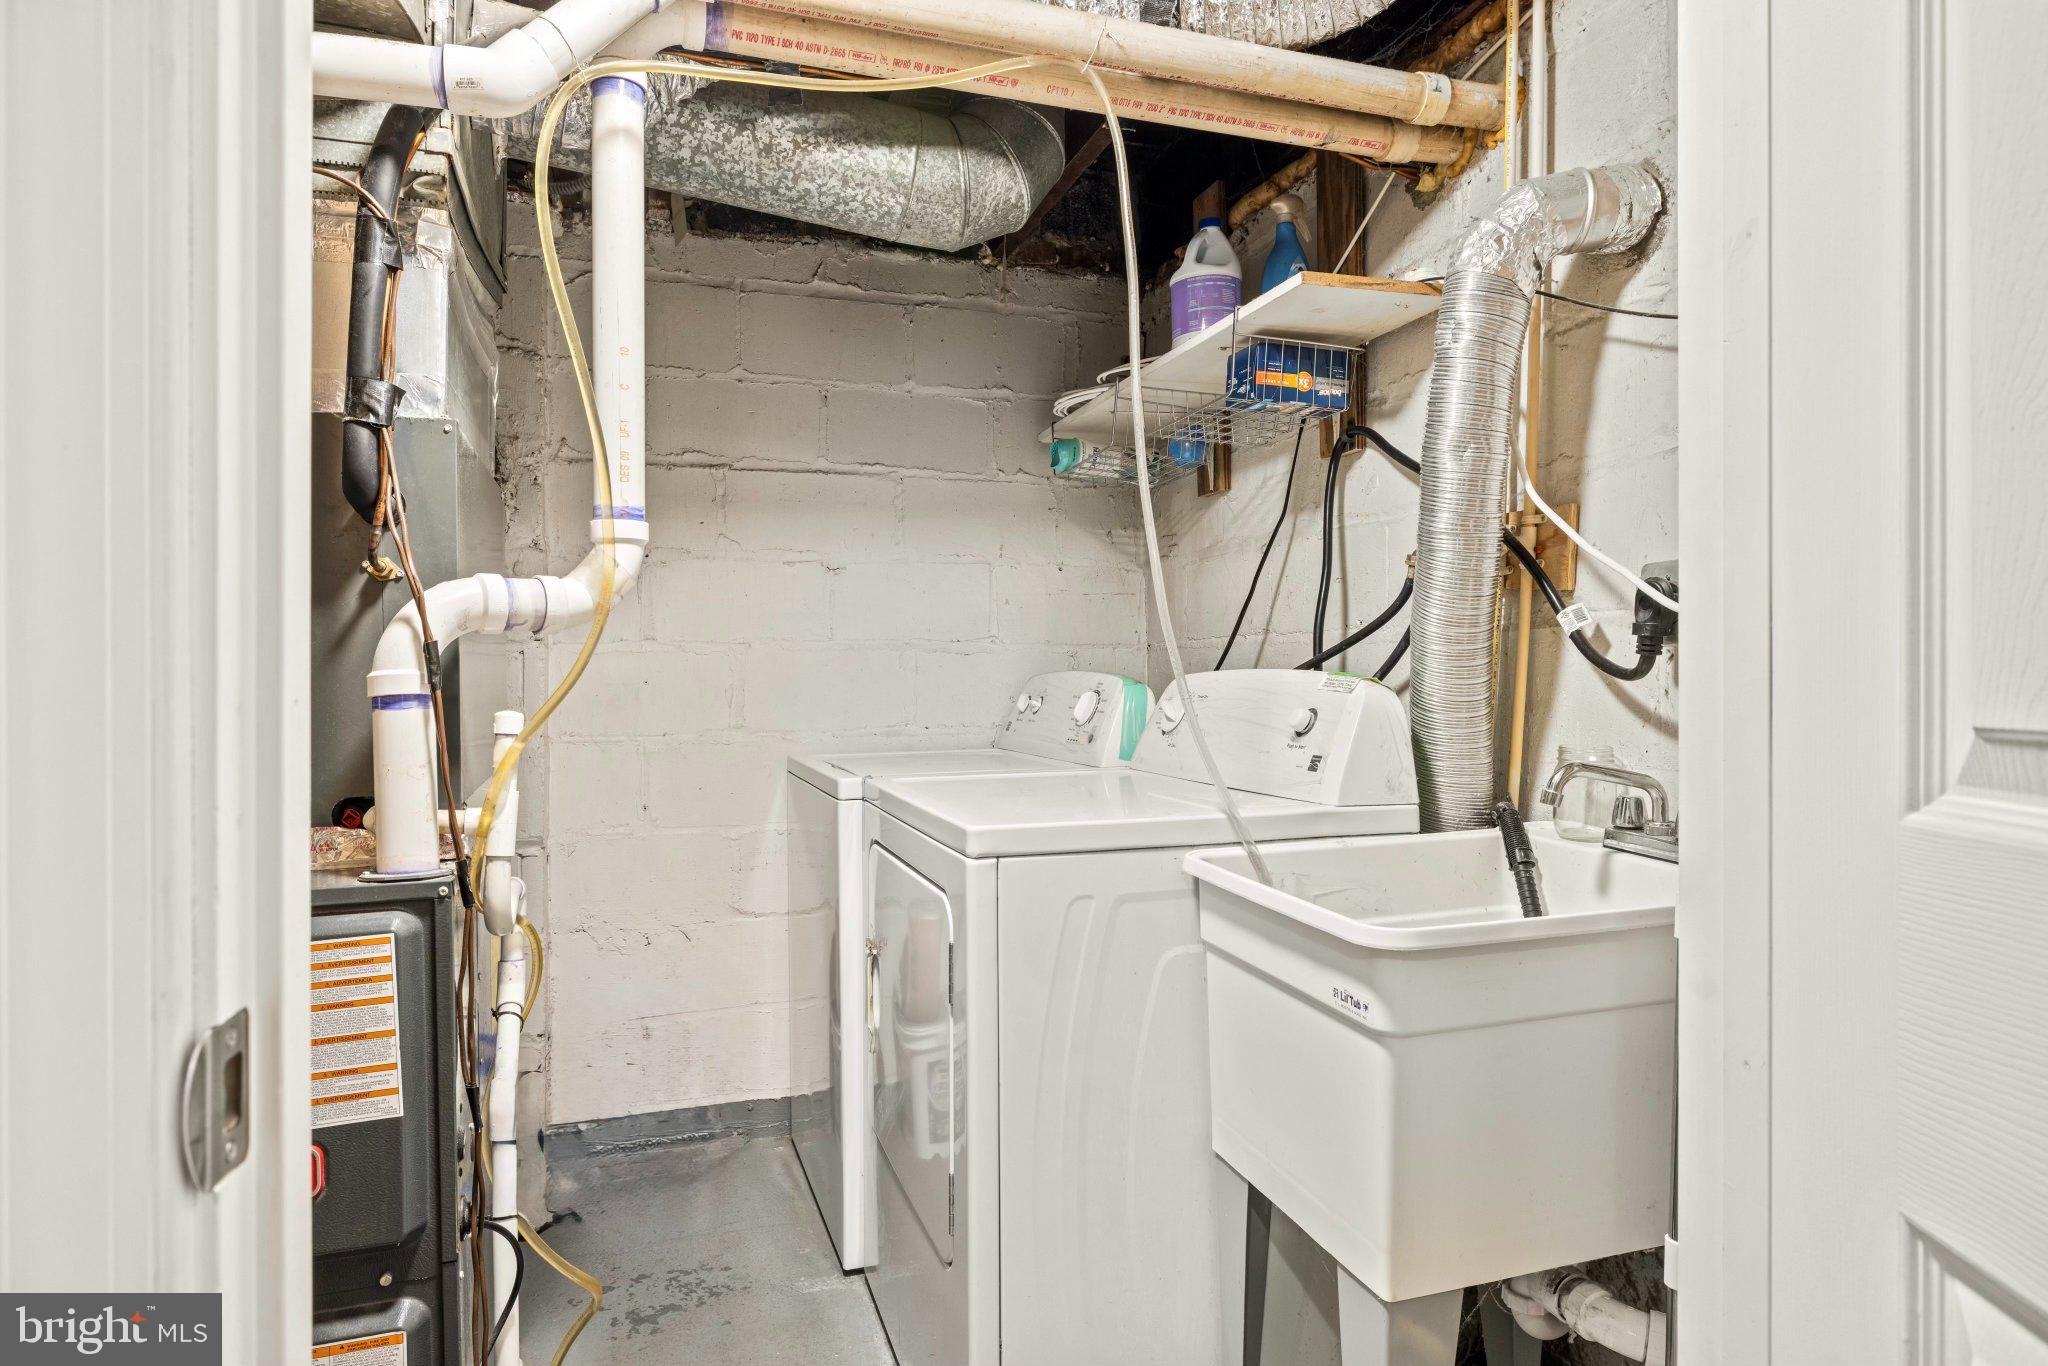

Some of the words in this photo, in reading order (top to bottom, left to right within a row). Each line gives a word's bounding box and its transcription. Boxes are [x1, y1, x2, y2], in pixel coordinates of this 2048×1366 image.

[731, 29, 743, 41] PVC
[761, 34, 775, 46] TYPE
[781, 38, 793, 49] SCH
[795, 40, 804, 51] 40
[805, 42, 822, 54] ASTM
[333, 941, 361, 949] WARNING
[327, 958, 375, 968] AVERTISSEMENT
[332, 977, 373, 986] ADVERTENCIA
[326, 1002, 354, 1010] WARNING
[320, 1034, 368, 1044] AVERTISSEMENT
[331, 1069, 359, 1077] WARNING
[323, 1092, 371, 1102] AVERTISSEMENT
